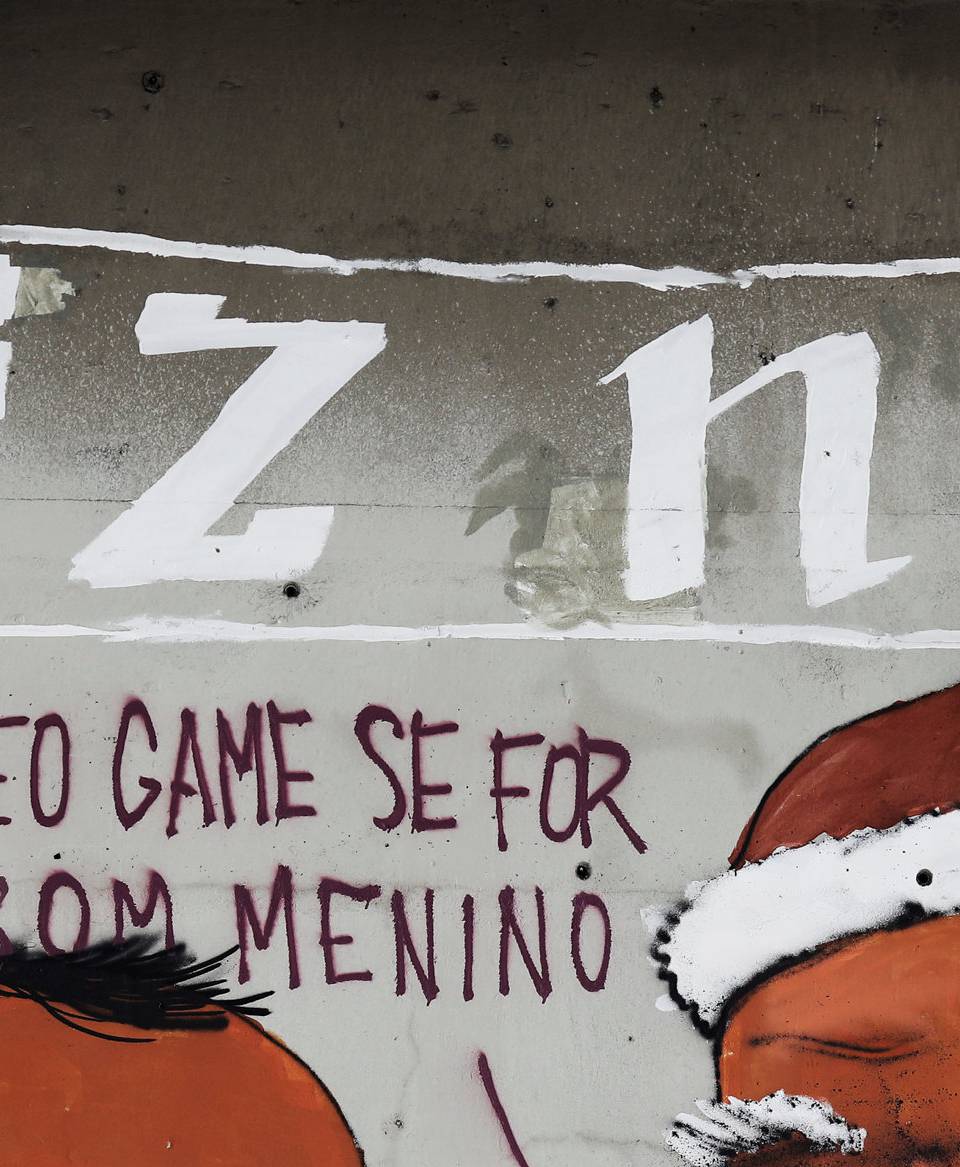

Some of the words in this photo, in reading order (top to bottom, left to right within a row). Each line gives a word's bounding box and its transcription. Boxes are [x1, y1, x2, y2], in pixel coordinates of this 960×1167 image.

[0, 255, 388, 588] z
[114, 697, 317, 835] GAME
[356, 704, 458, 831] SE
[490, 725, 645, 851] FOR
[0, 870, 173, 954] OM
[233, 865, 610, 1000] MENINO
